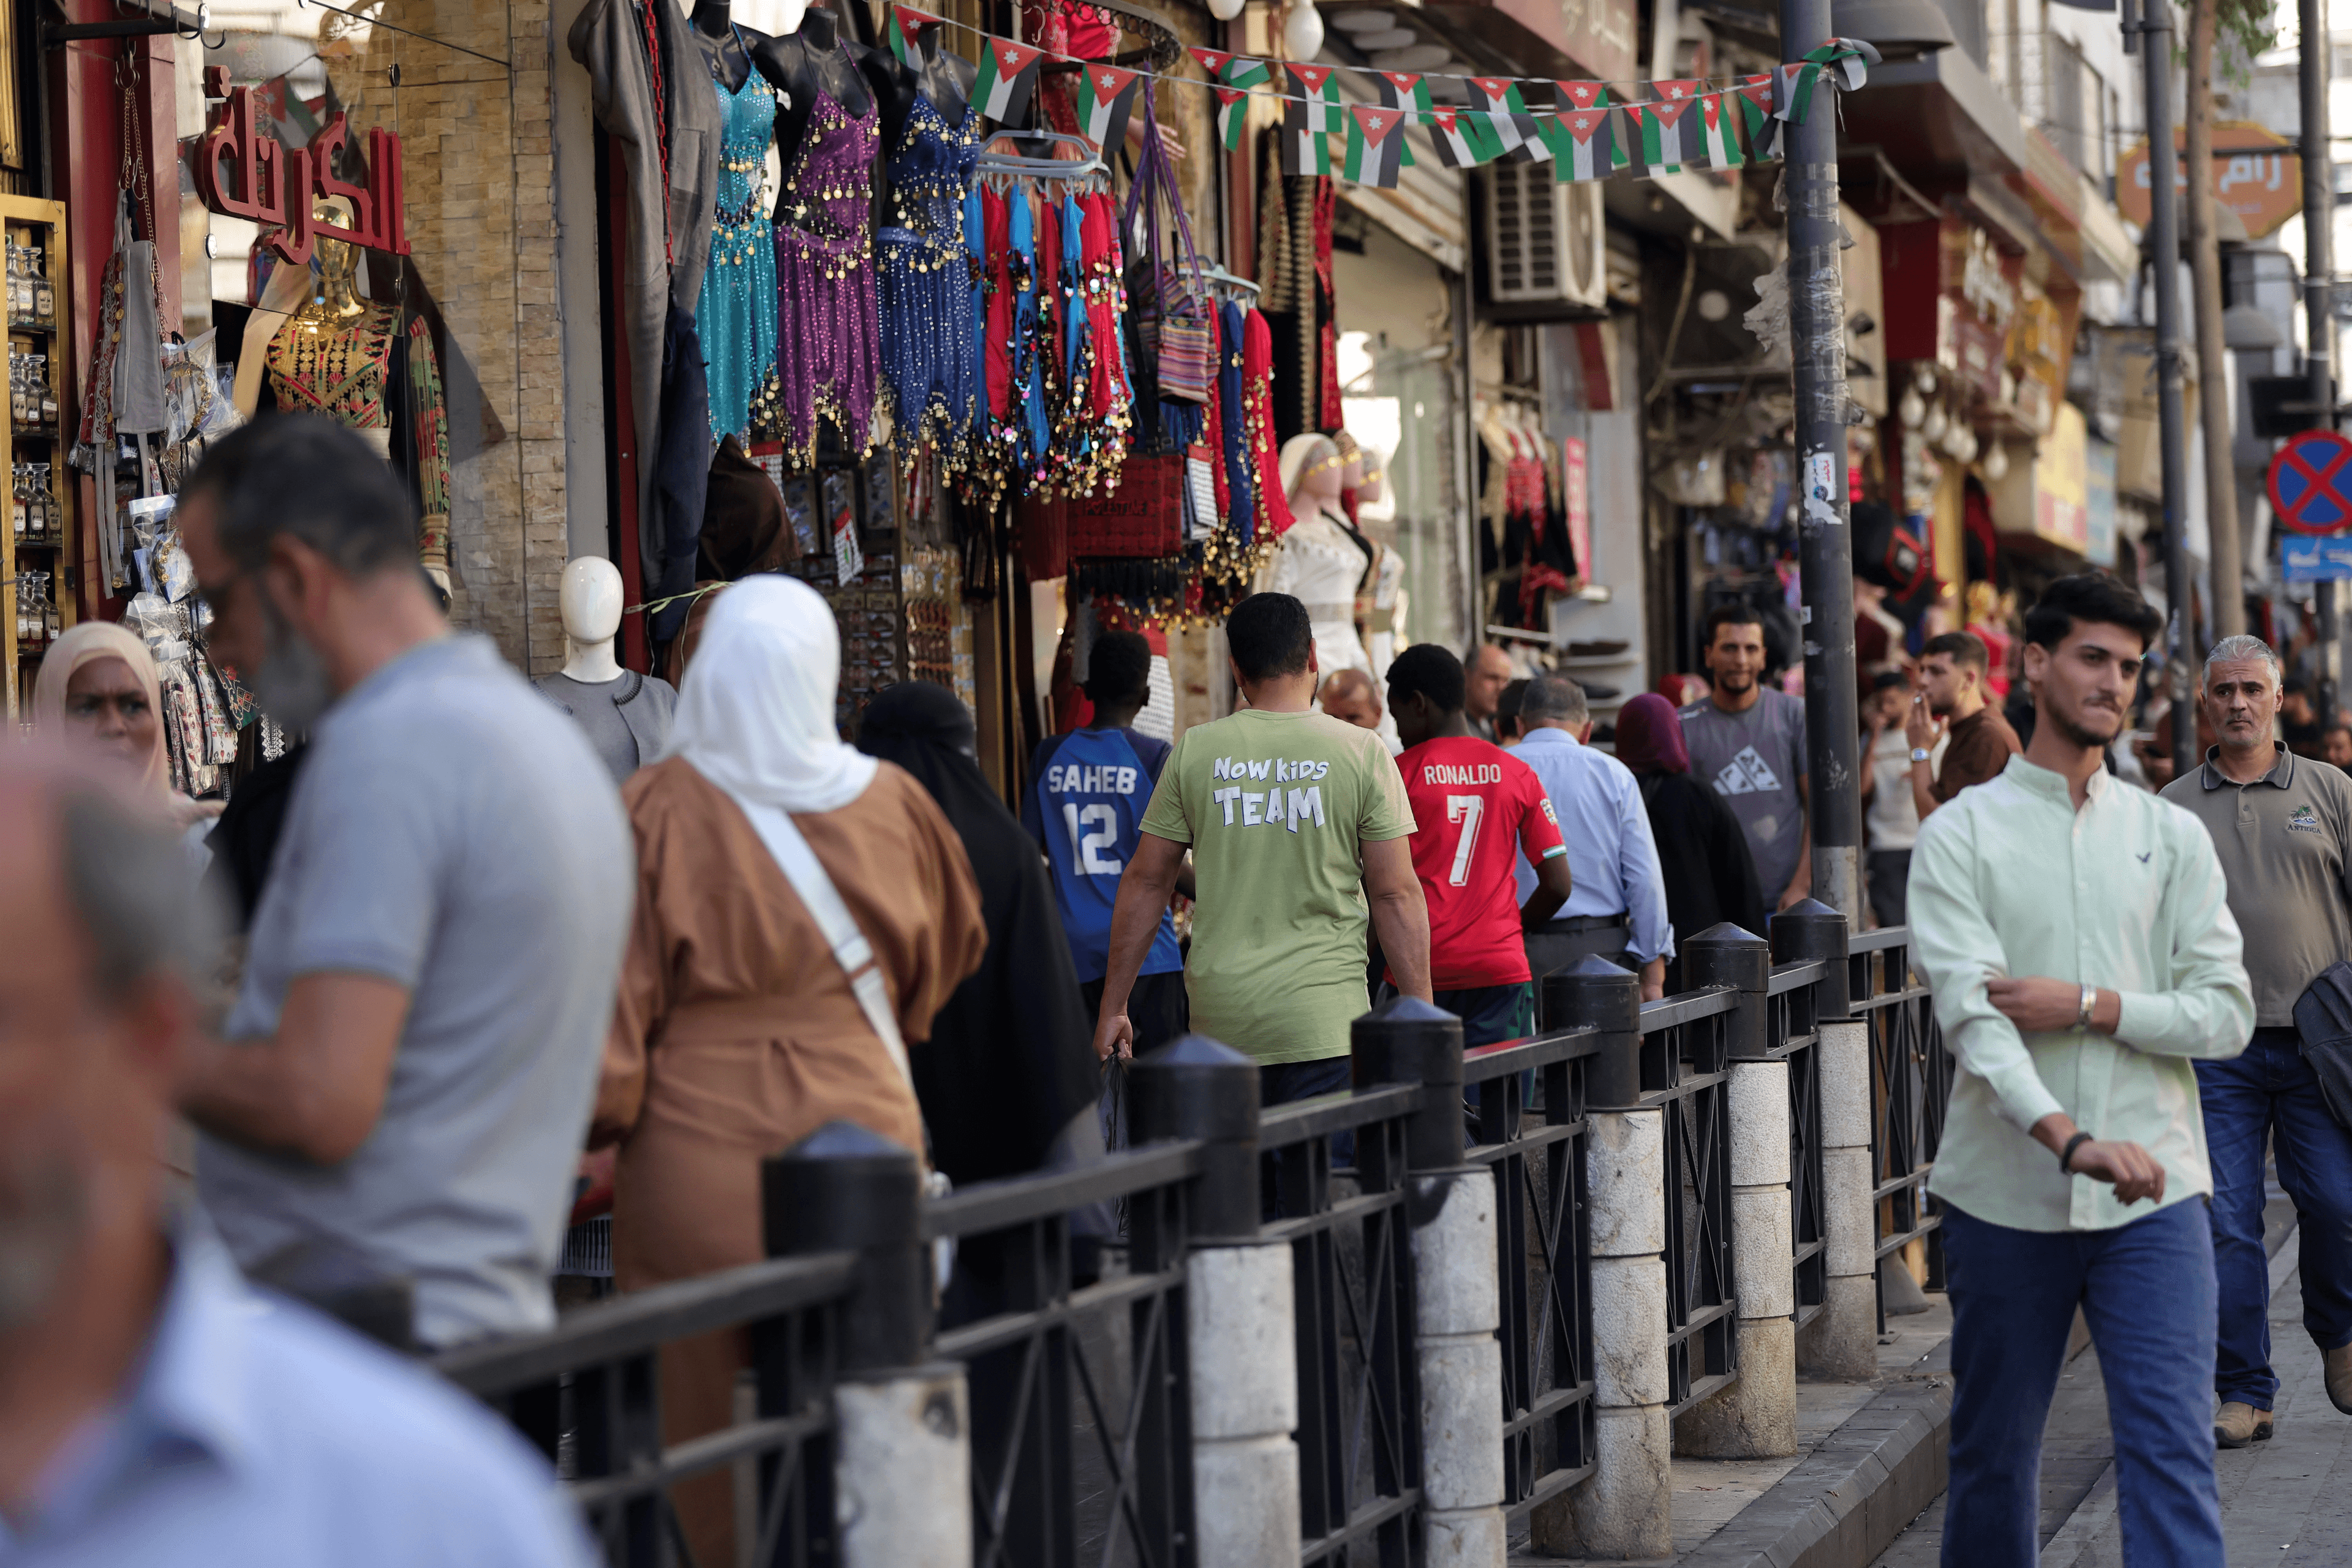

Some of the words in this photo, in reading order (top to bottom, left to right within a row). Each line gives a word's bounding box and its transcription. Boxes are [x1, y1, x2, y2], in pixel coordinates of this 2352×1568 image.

[1048, 764, 1137, 795] SAHEB
[1424, 764, 1502, 786] RONALDO
[1213, 786, 1326, 834] TEAM
[2286, 824, 2322, 835] ANTIGUA
[1062, 802, 1123, 876] 12
[1447, 794, 1485, 887] 7
